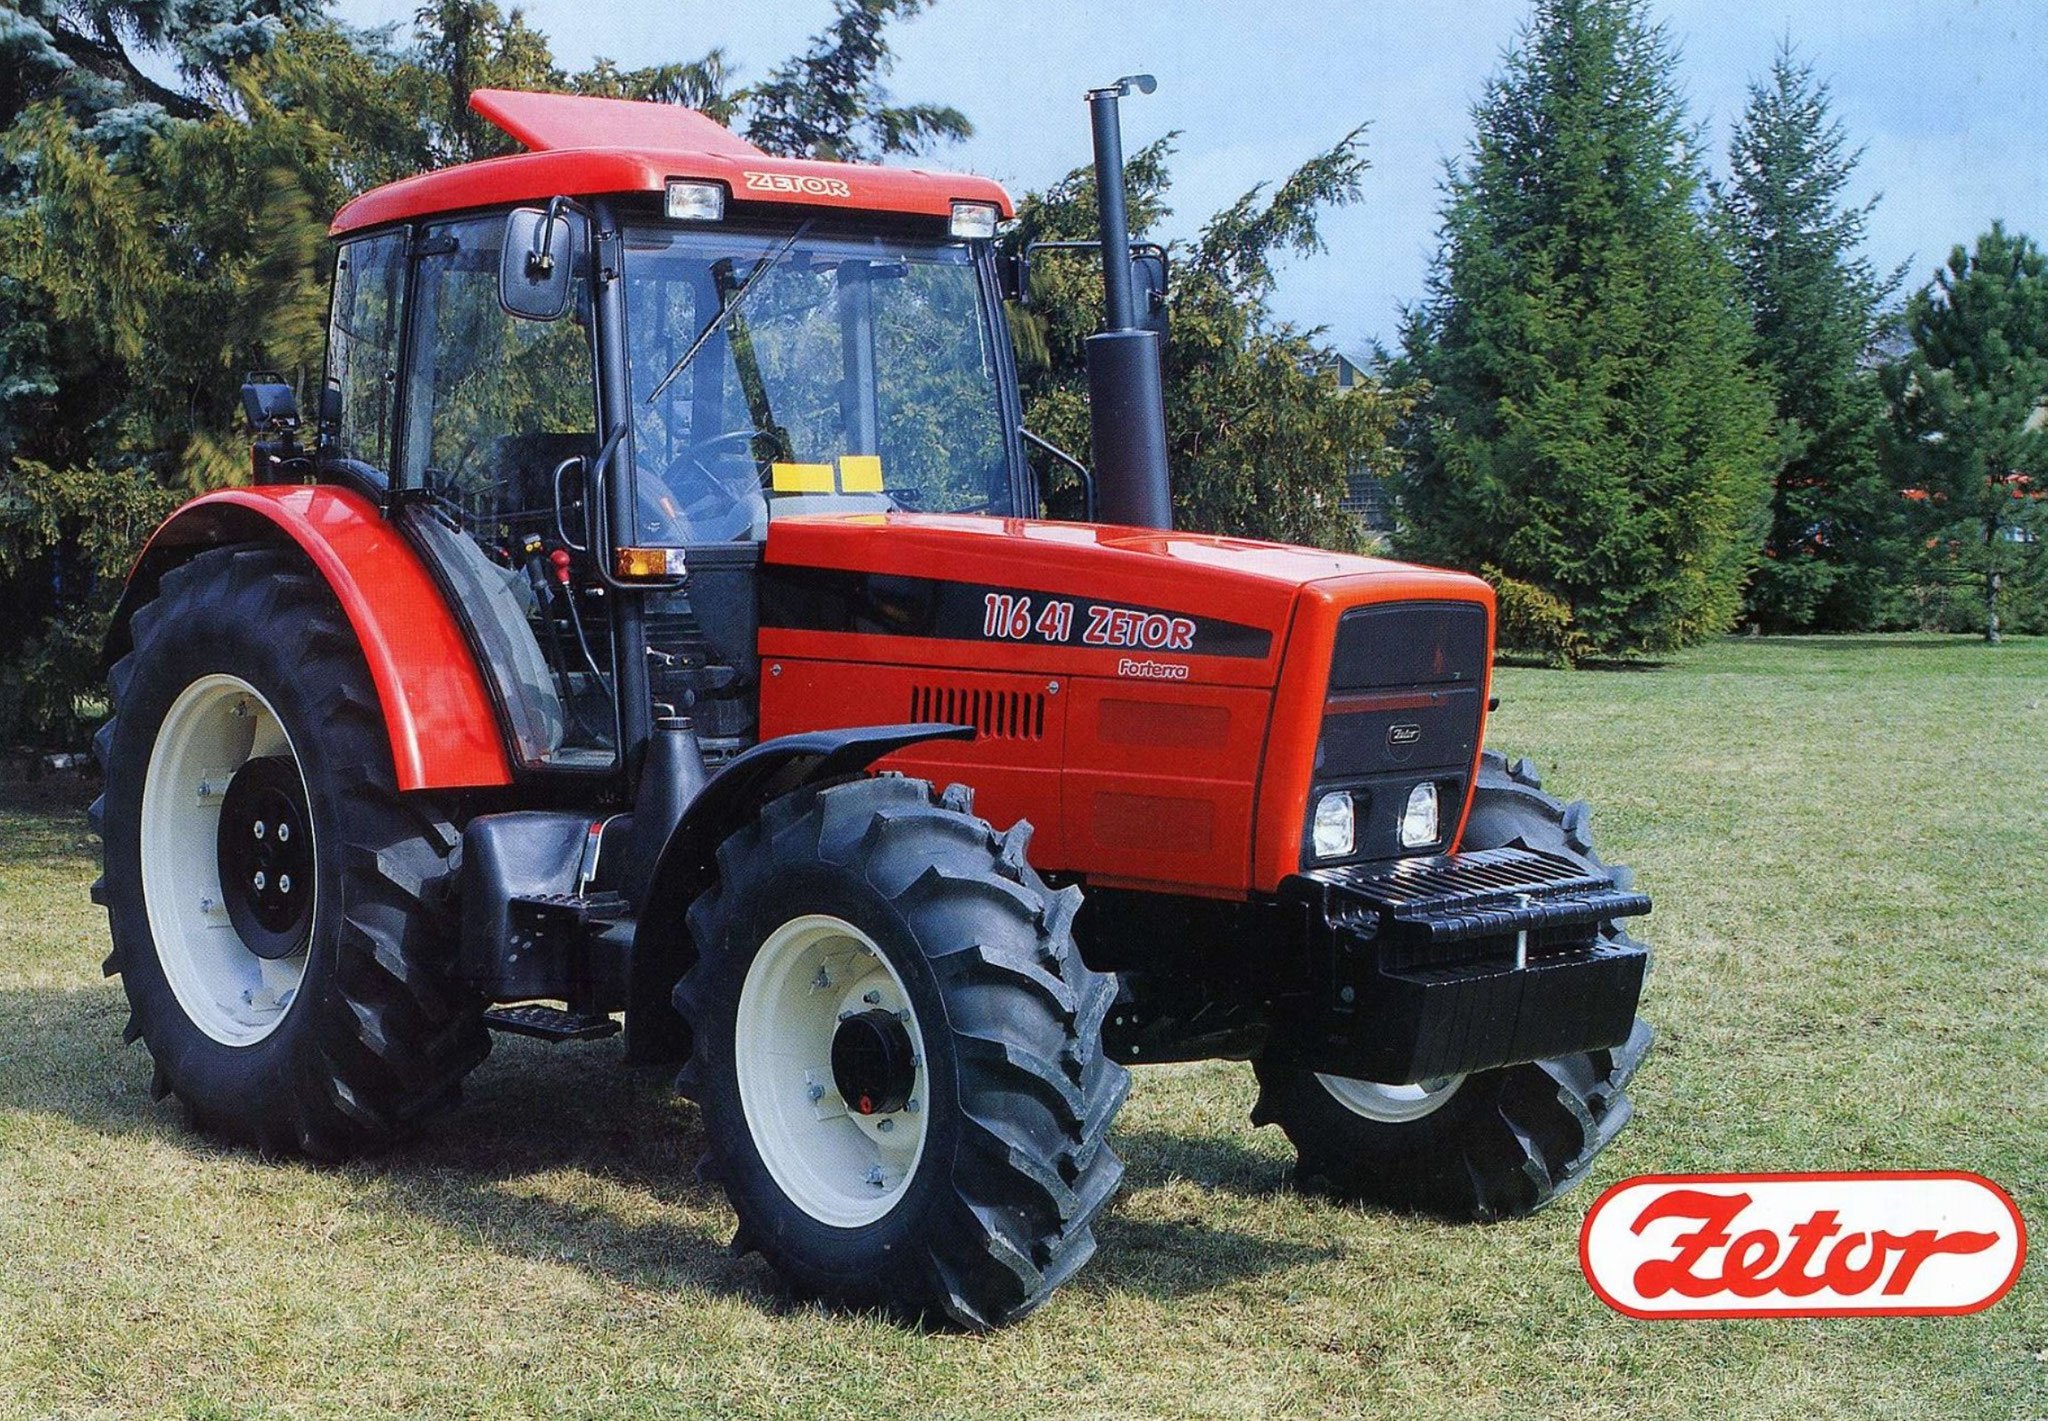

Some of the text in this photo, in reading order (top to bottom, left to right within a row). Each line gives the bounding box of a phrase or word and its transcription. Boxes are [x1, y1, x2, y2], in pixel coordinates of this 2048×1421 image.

[743, 171, 851, 197] ZETOR
[983, 593, 1196, 649] 116 41 ZETOR
[1118, 658, 1189, 679] Forterra
